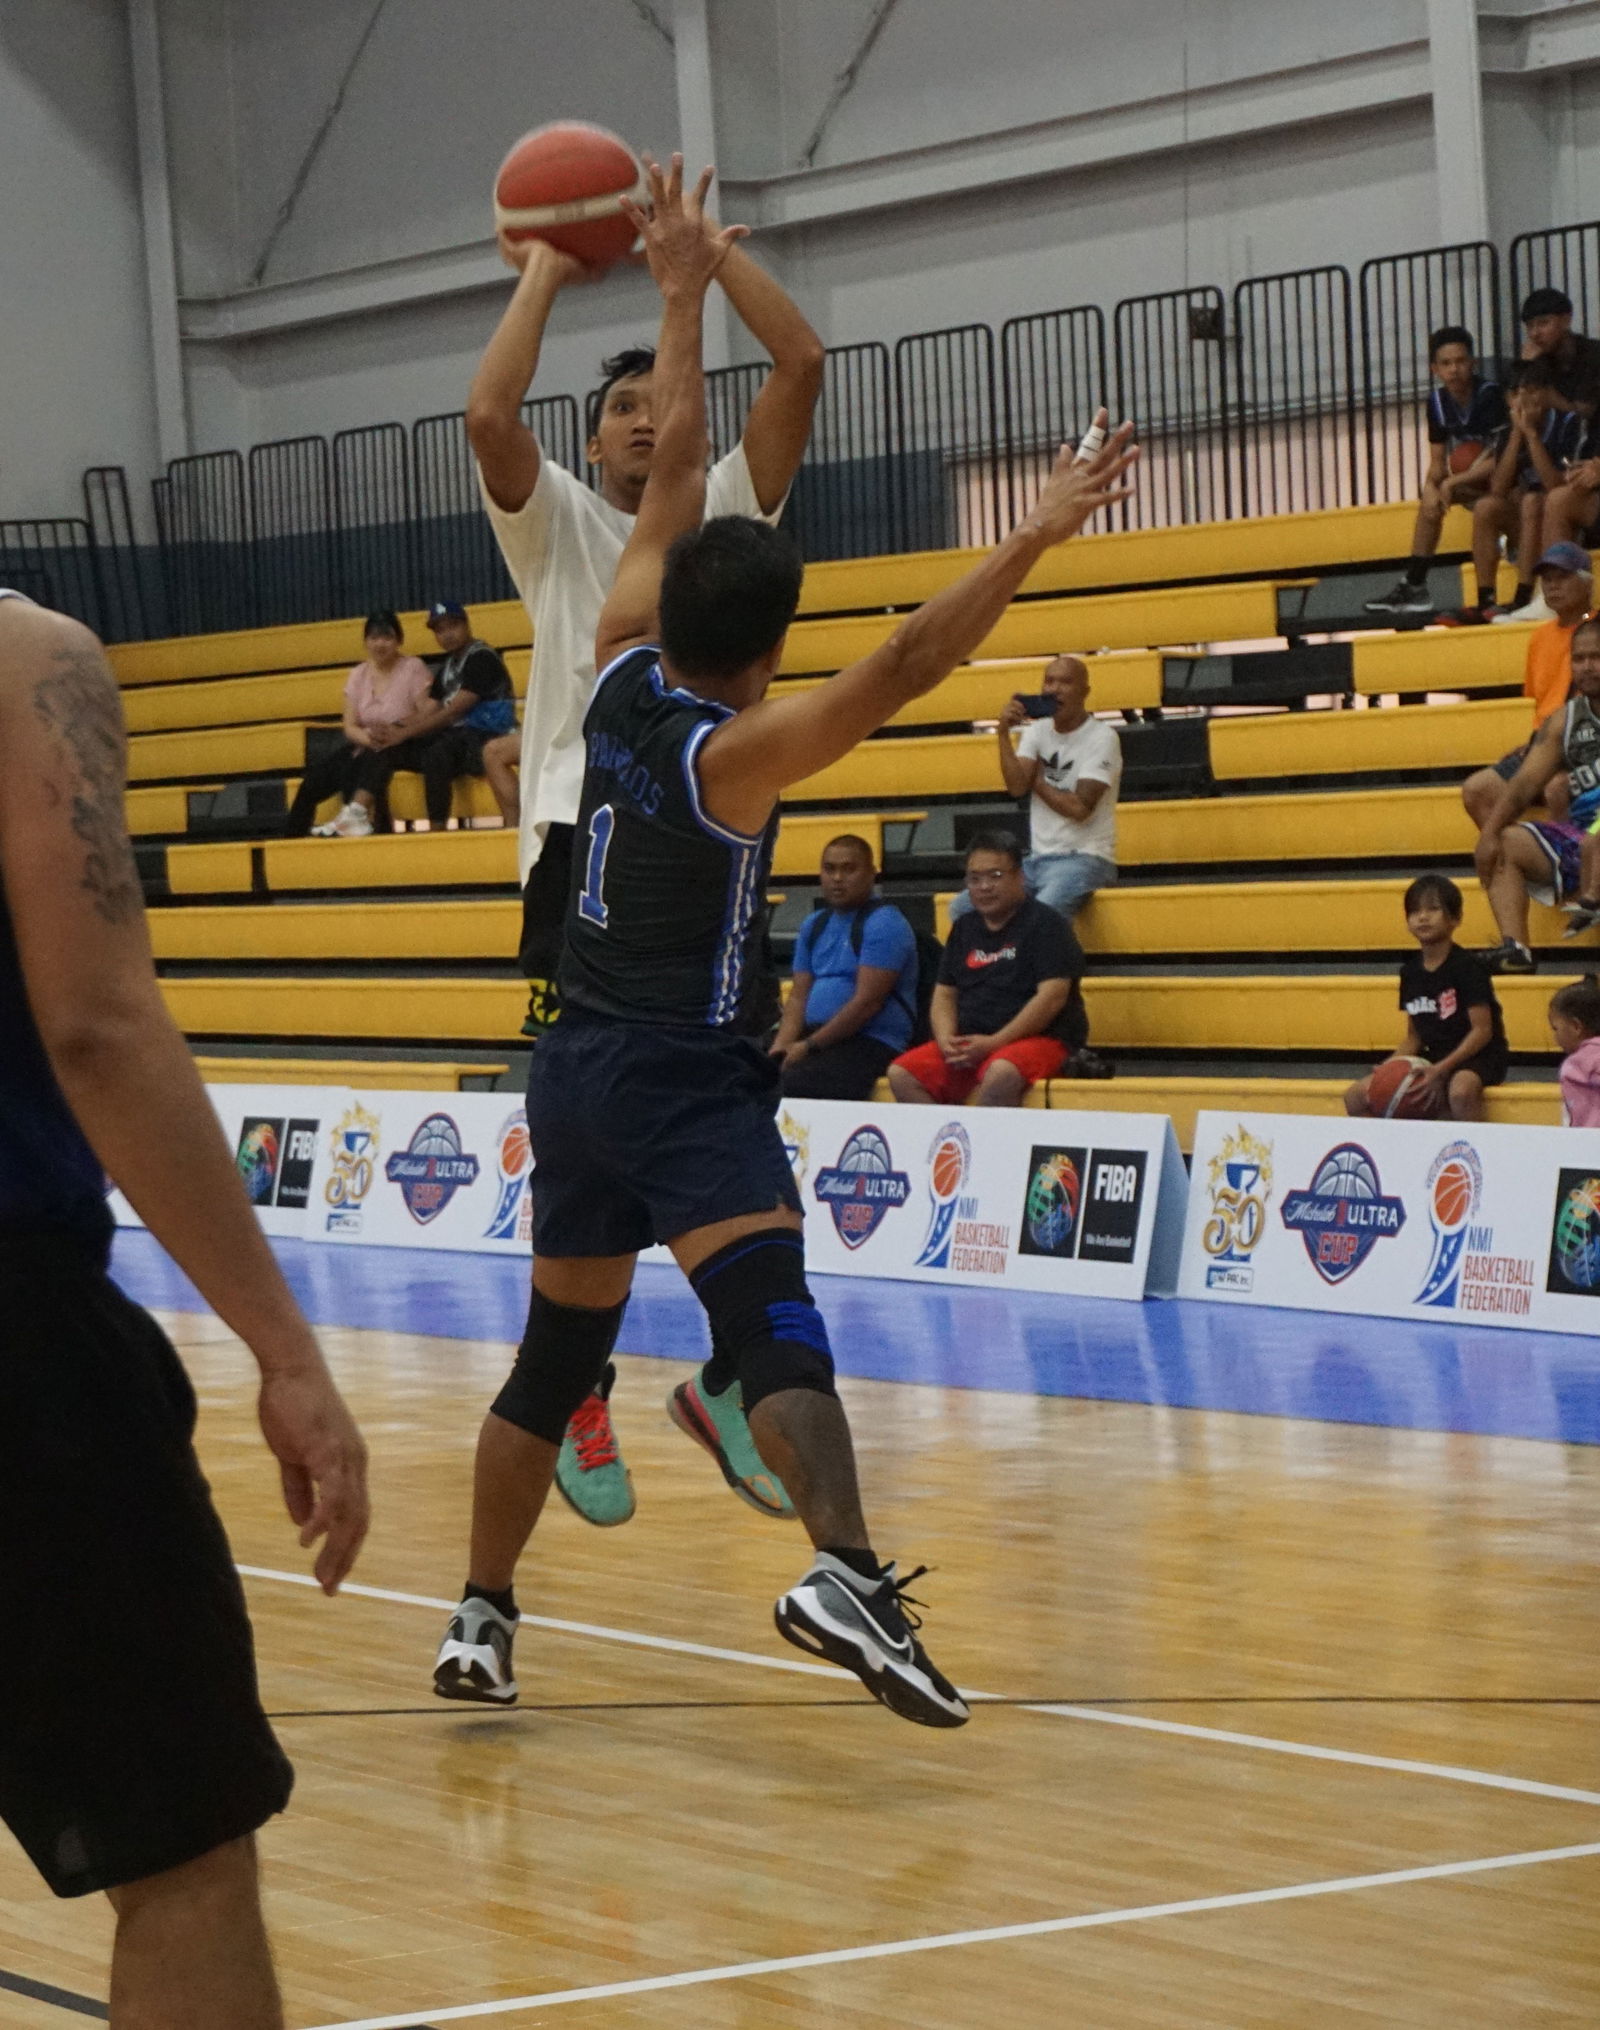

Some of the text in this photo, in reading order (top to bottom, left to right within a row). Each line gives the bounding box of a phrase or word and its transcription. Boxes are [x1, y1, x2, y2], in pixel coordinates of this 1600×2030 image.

[578, 803, 615, 929] 1
[325, 1151, 374, 1205] 50
[436, 1160, 475, 1179] ULTRA
[1094, 1163, 1137, 1203] FIBA
[865, 1178, 906, 1199] ULTRA
[841, 1203, 874, 1233] CUP
[958, 1196, 979, 1219] NMI
[1202, 1186, 1267, 1256] 50
[1347, 1203, 1399, 1228] ULTRA
[954, 1222, 1010, 1249] BASKETBALL
[1317, 1231, 1359, 1265] CUP
[1467, 1226, 1494, 1253] NMI
[952, 1248, 1008, 1275] FEDERATION
[1463, 1255, 1535, 1286] BASKETBALL
[1460, 1284, 1533, 1315] FEDERATION
